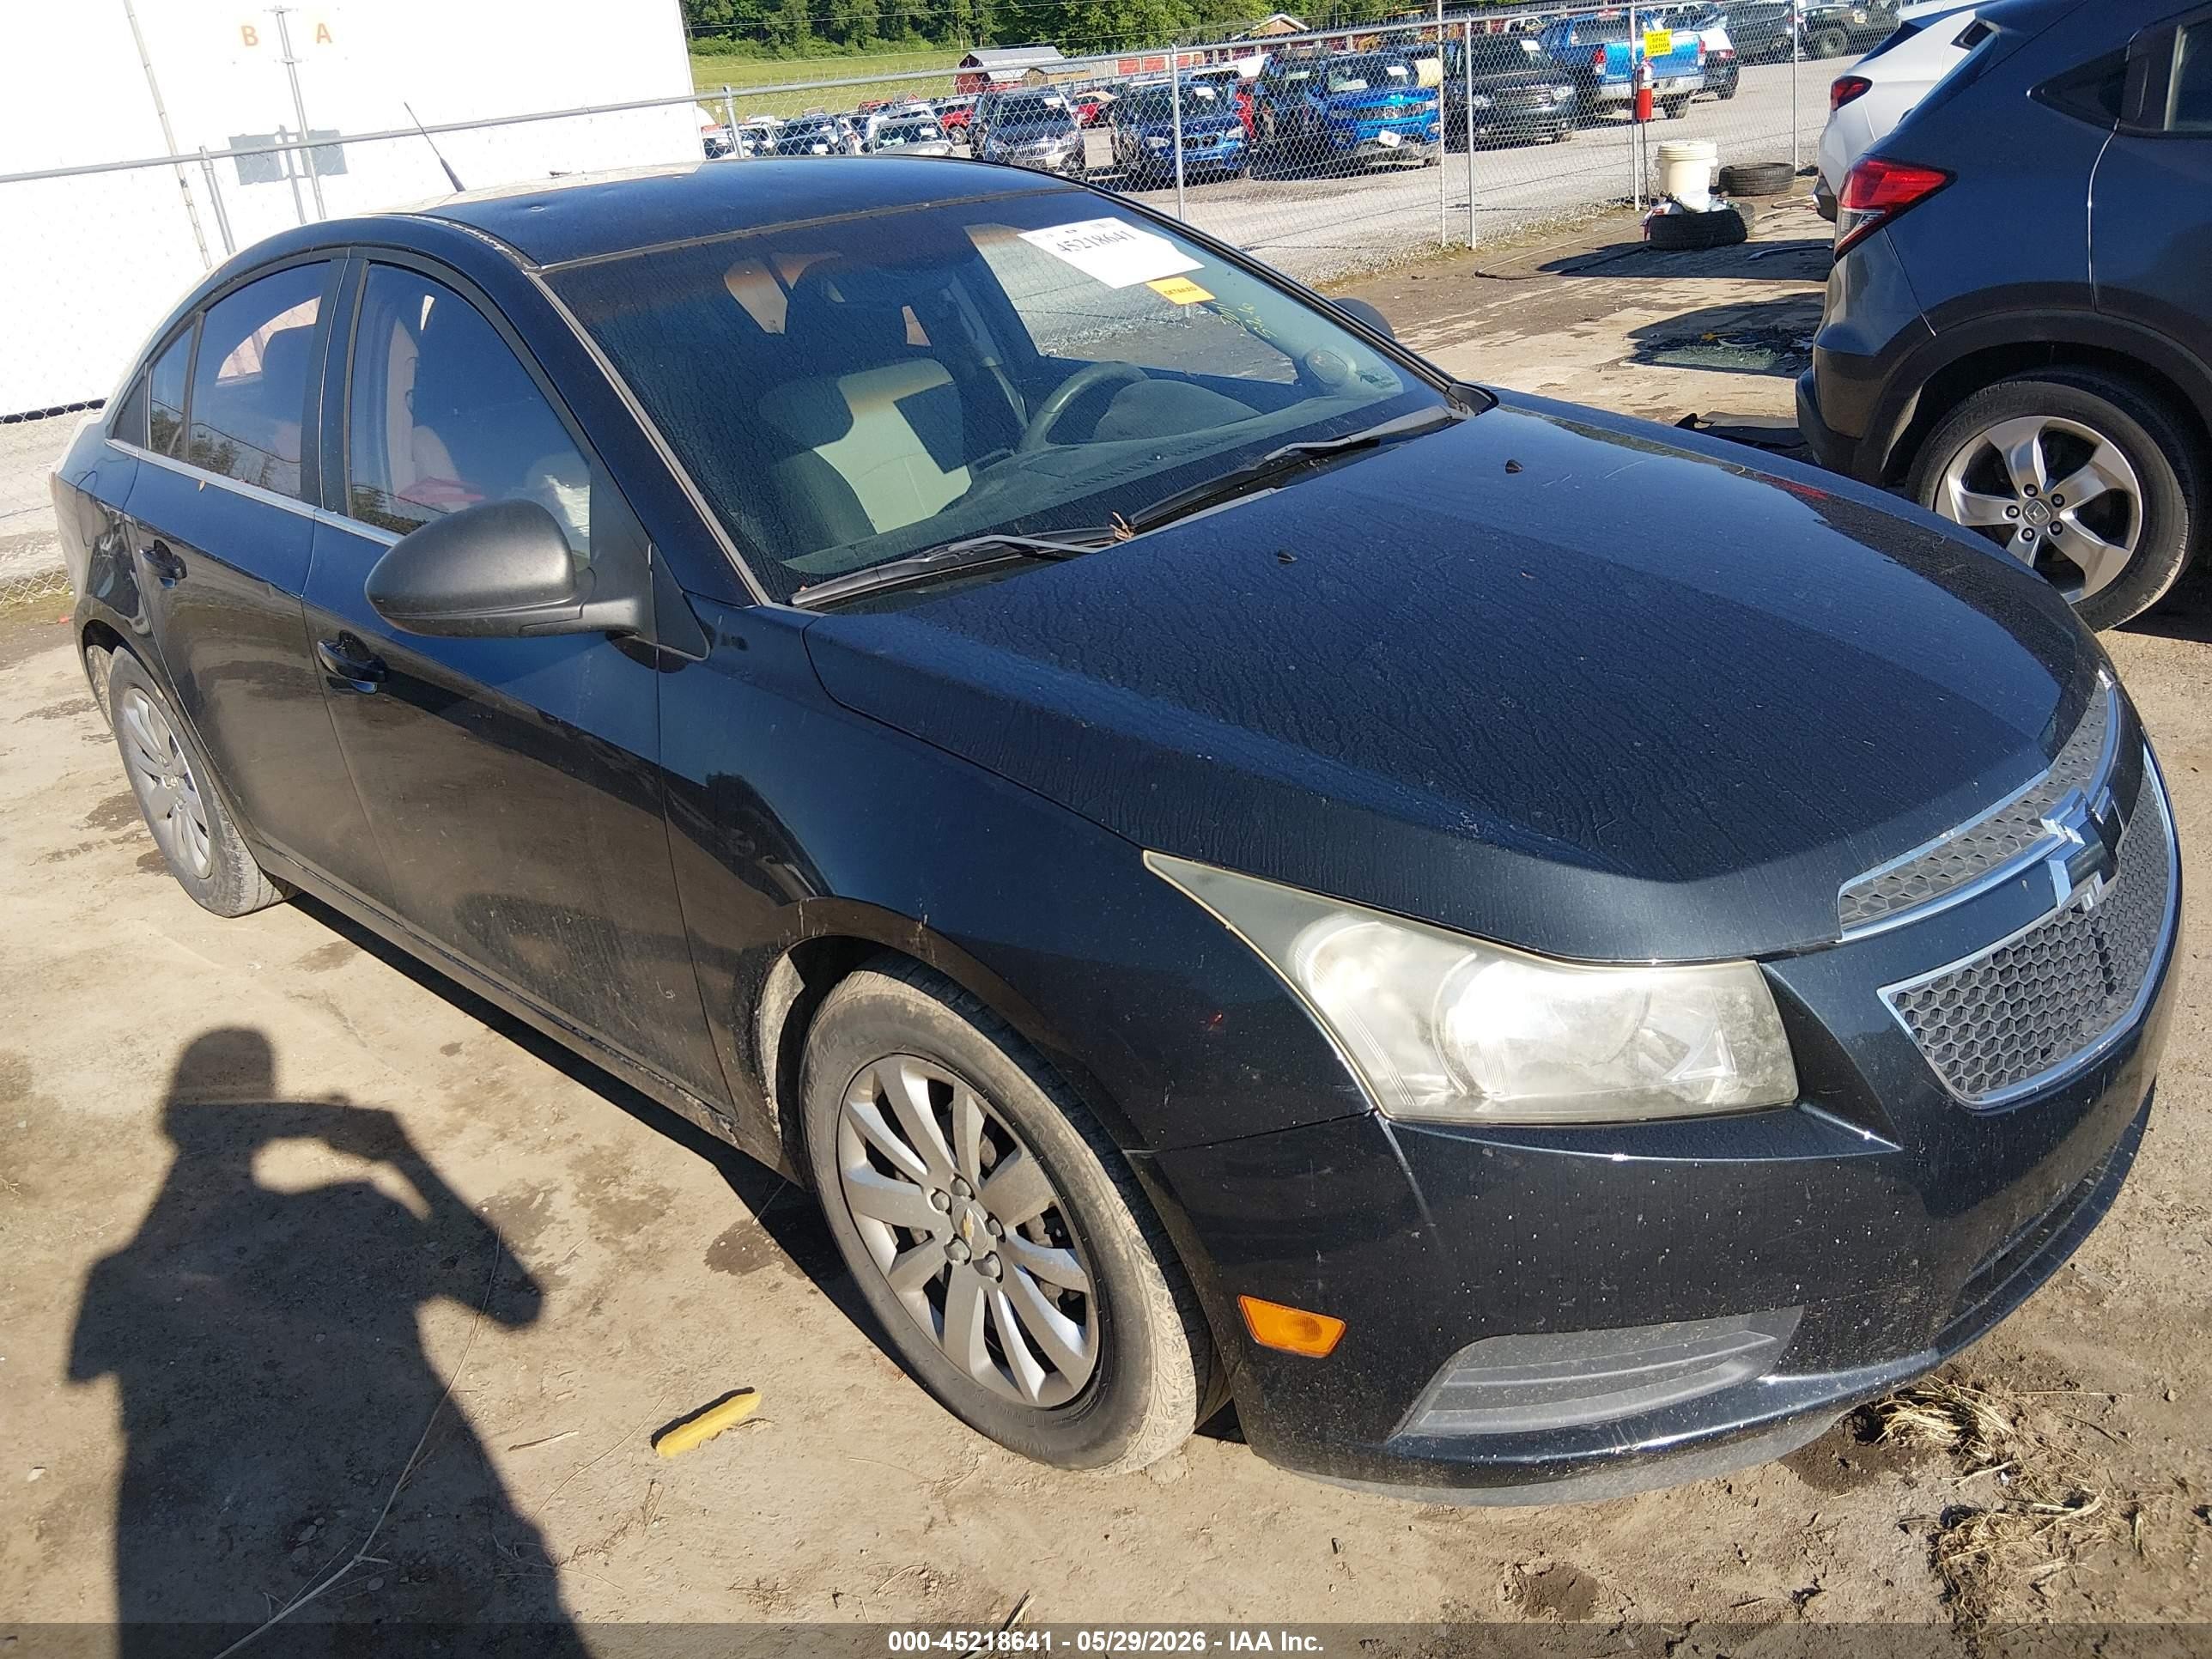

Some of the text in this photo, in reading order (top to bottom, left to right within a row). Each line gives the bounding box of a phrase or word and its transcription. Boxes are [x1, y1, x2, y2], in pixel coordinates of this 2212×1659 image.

[240, 25, 259, 47] B
[315, 22, 333, 45] A
[1056, 230, 1137, 252] 45218641
